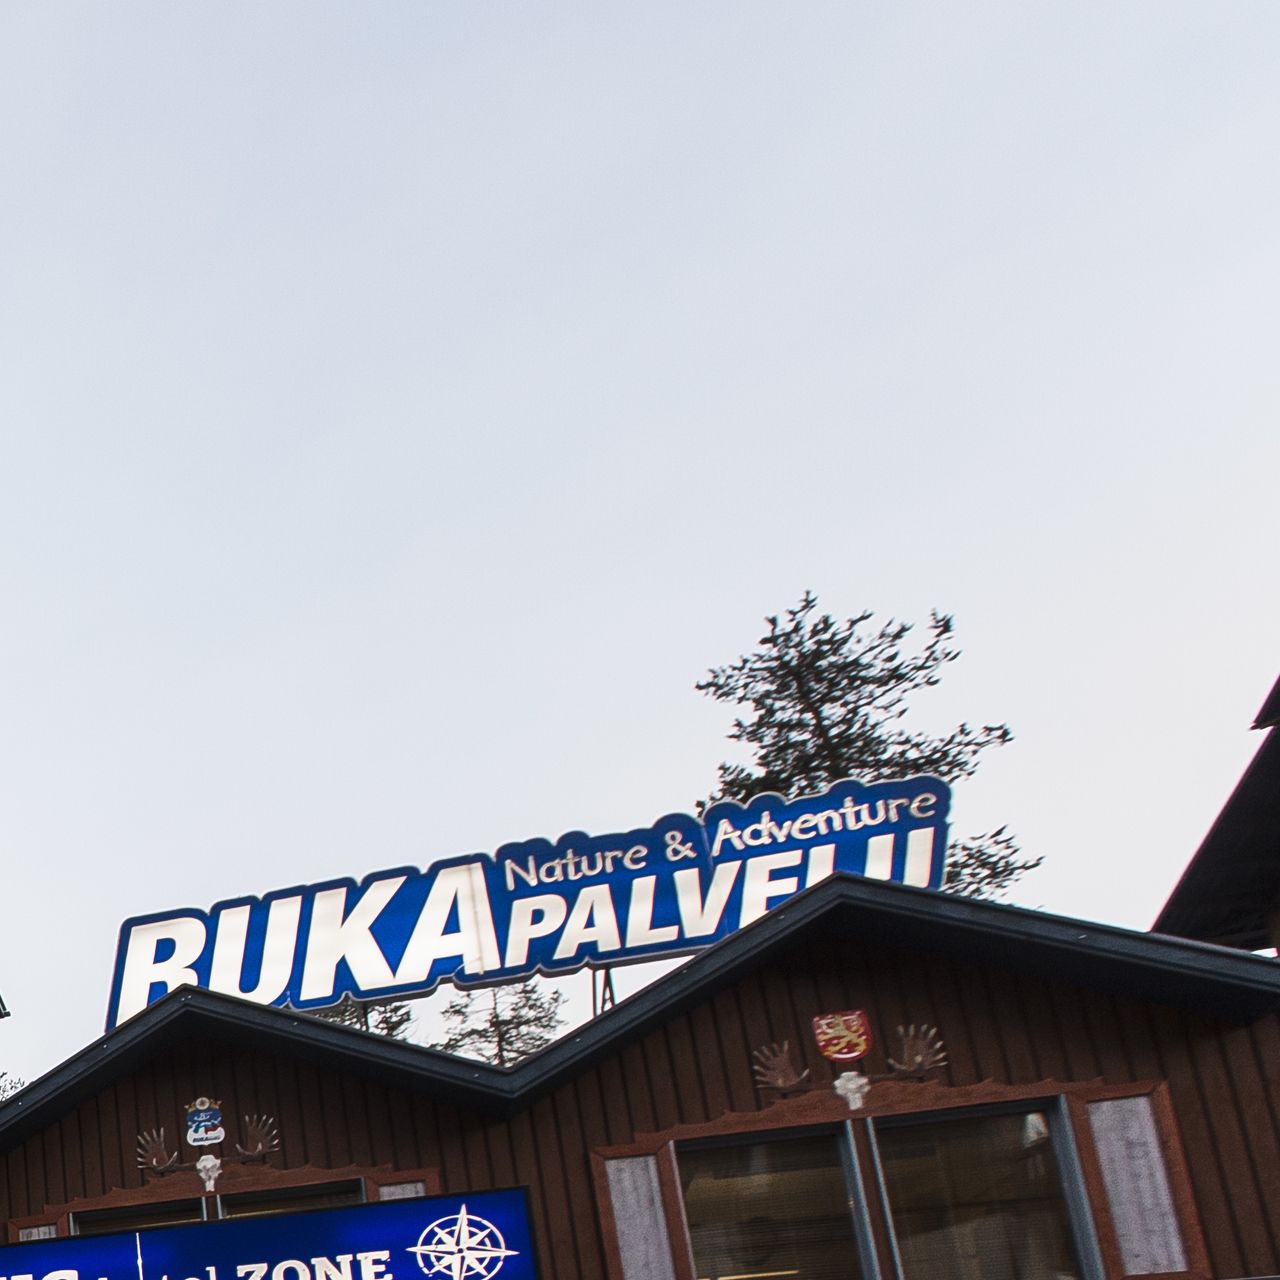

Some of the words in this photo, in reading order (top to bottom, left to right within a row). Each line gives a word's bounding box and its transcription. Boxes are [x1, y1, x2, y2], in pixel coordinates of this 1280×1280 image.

[505, 841, 649, 892] Nature
[665, 830, 696, 860] &
[711, 792, 938, 857] Adventure
[115, 862, 502, 1027] RUKA
